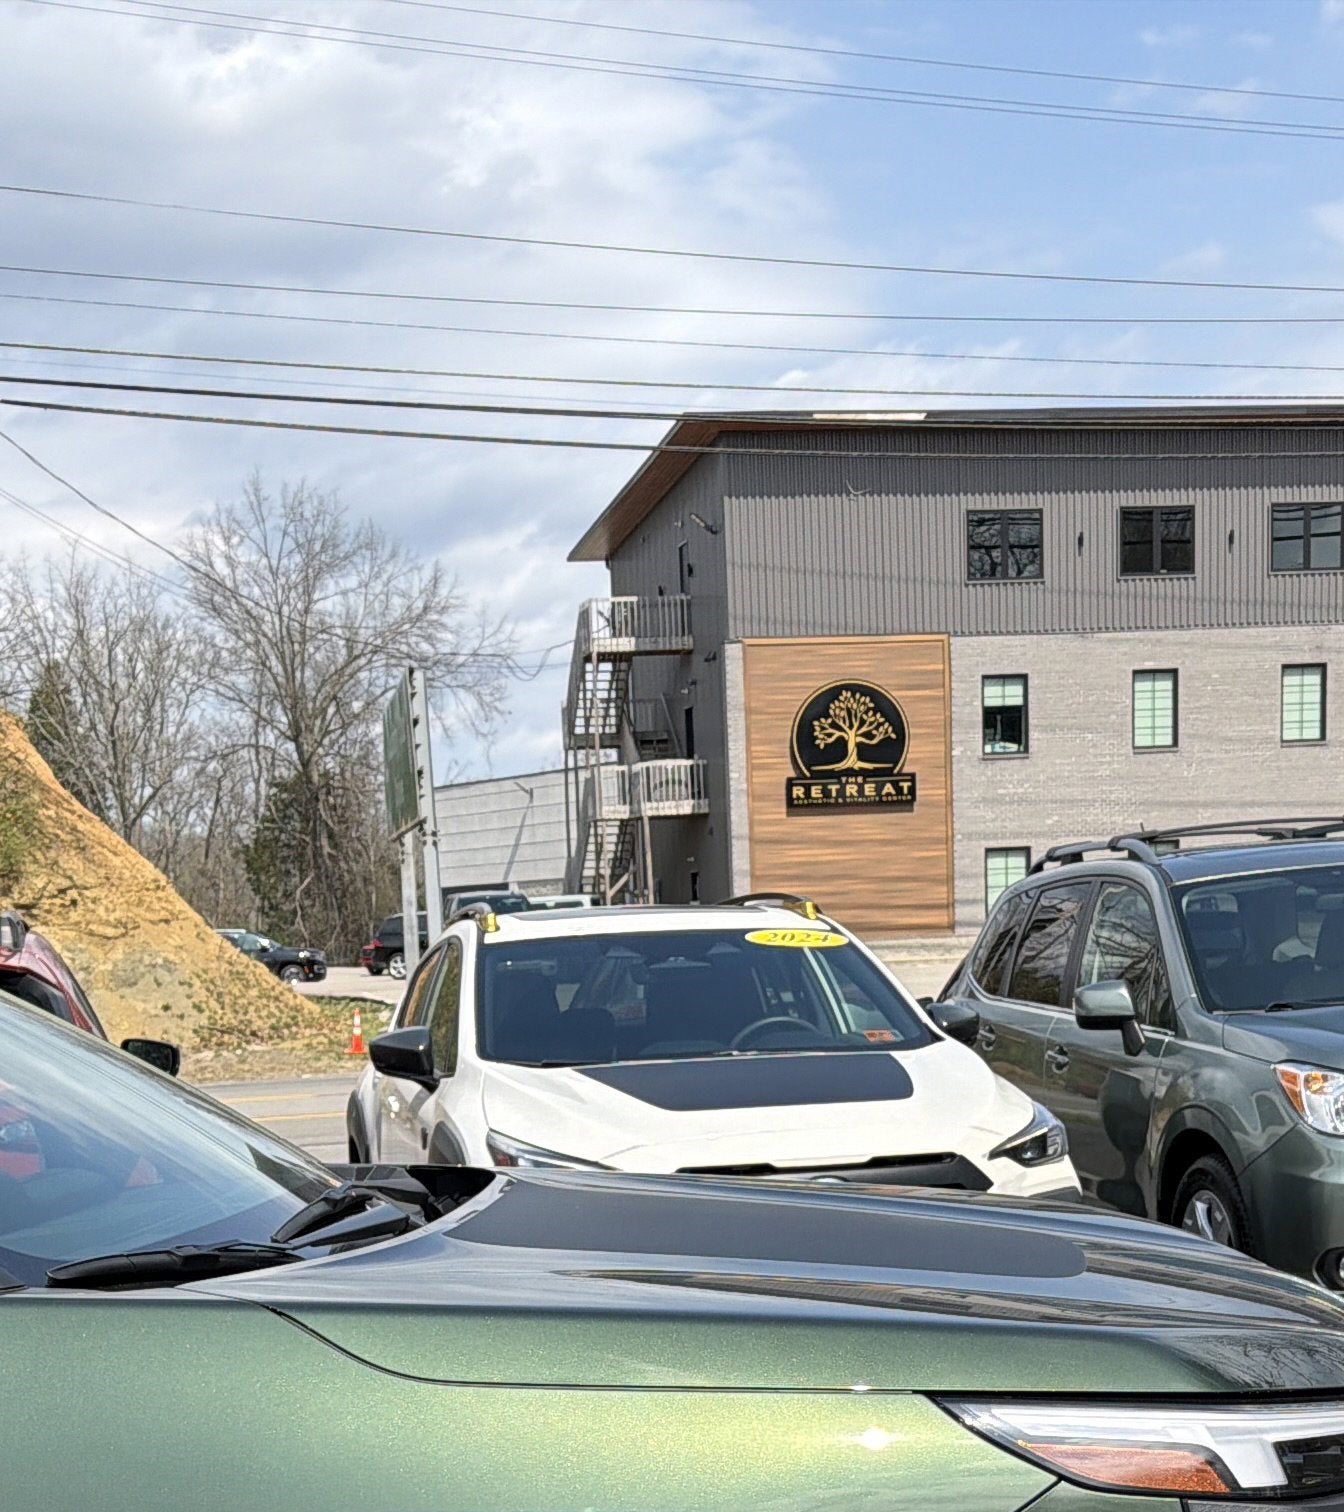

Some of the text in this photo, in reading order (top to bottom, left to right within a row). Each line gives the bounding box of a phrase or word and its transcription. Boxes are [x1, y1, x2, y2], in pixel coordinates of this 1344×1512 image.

[840, 776, 864, 784] THE
[792, 782, 912, 798] RETREAT
[766, 931, 830, 943] 2024
